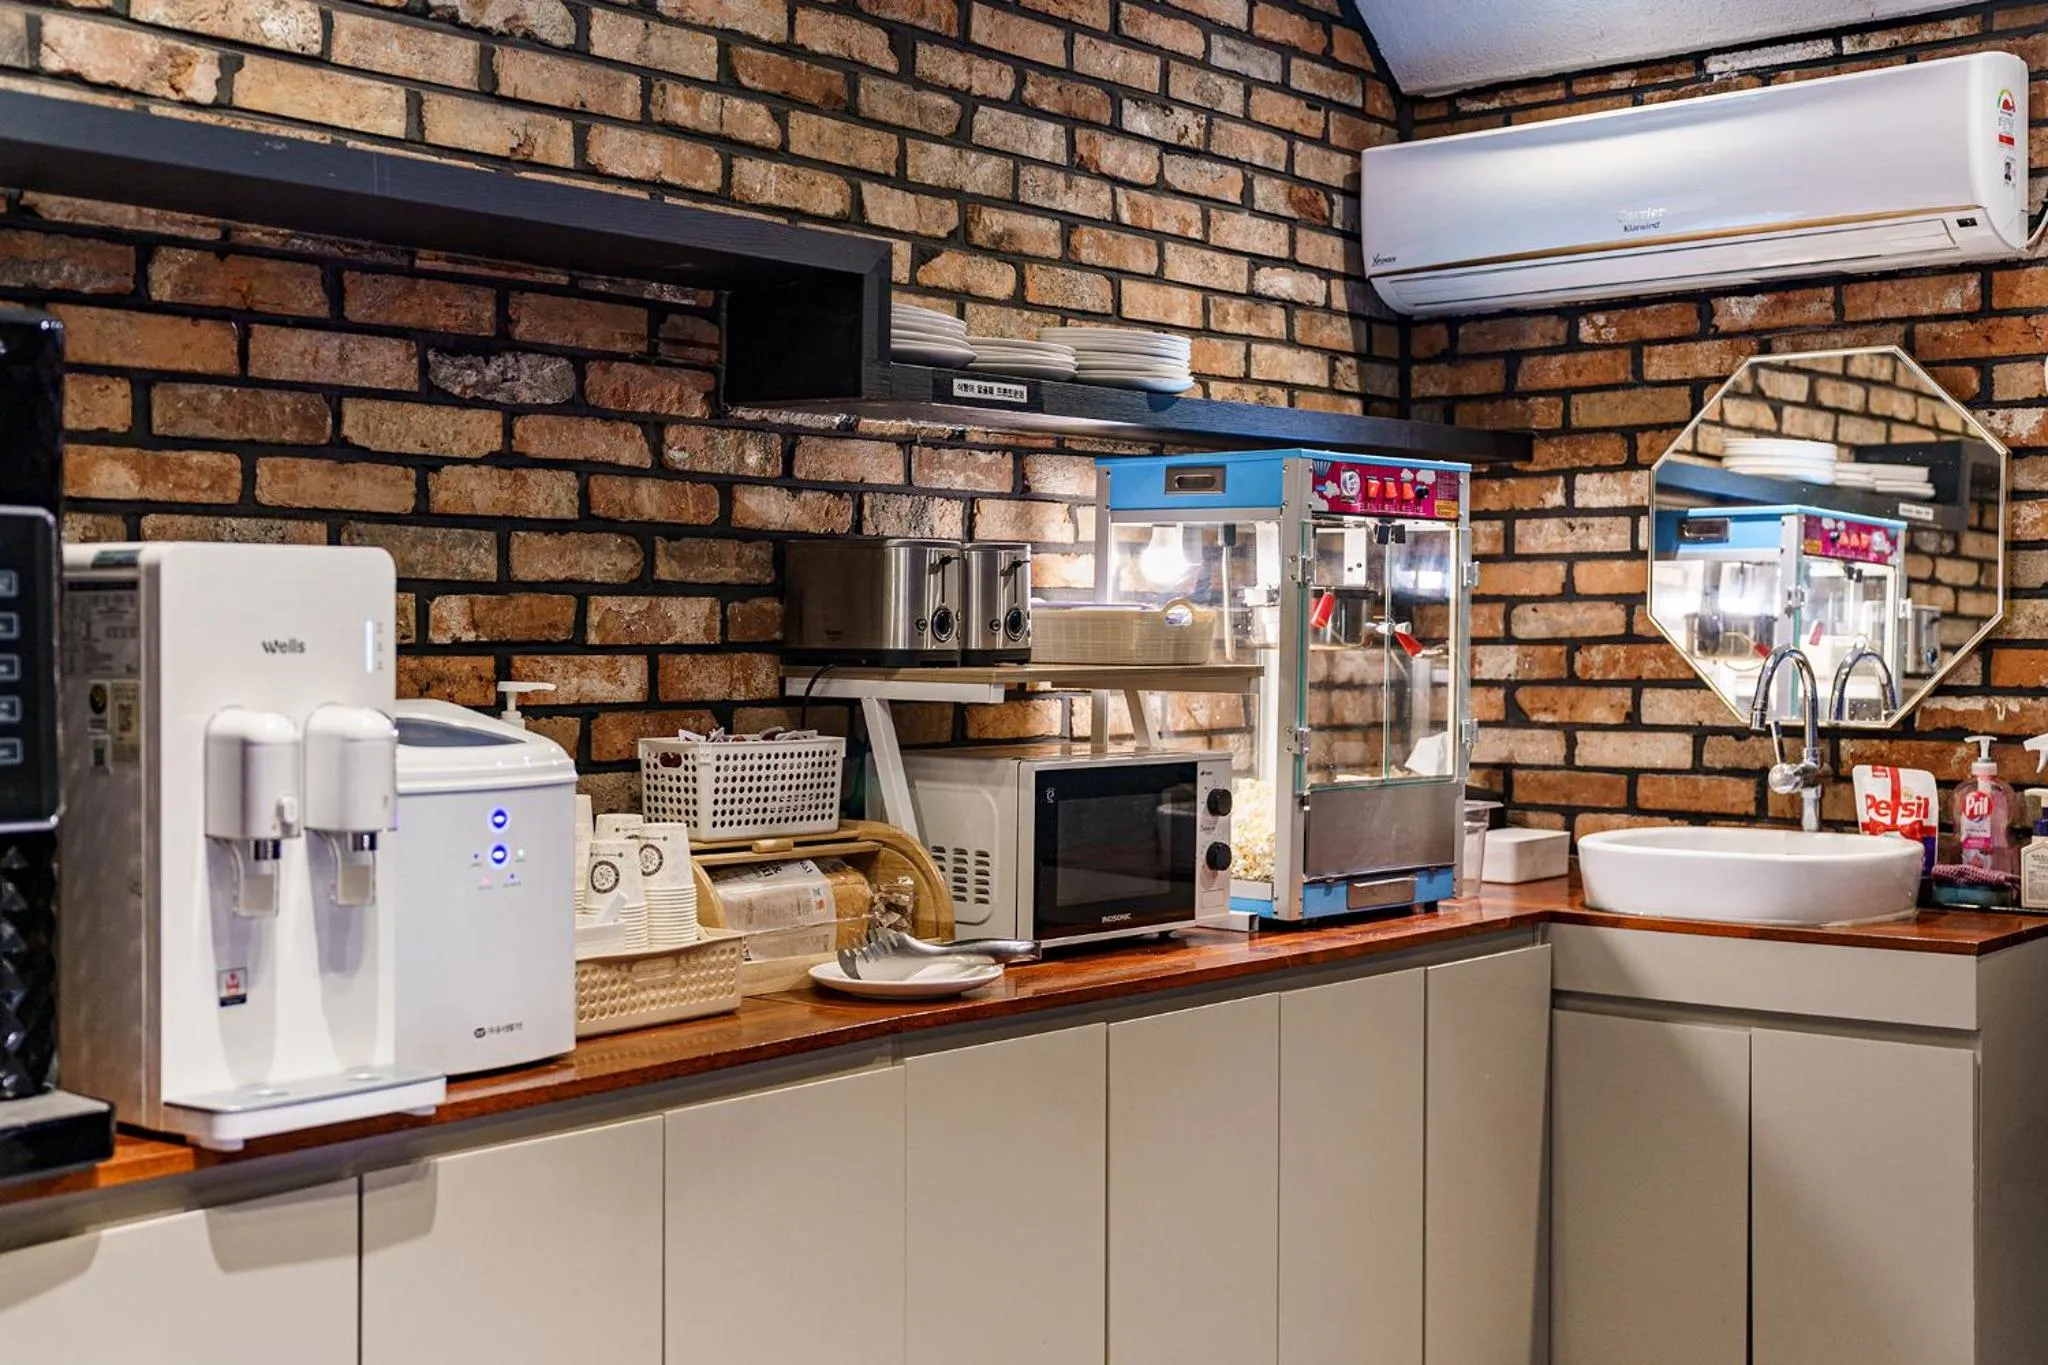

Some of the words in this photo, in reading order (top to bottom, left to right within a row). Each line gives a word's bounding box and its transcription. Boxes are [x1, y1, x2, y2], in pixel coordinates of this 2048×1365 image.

[261, 638, 305, 655] Wells
[1865, 793, 1930, 818] Persil
[1966, 793, 1989, 815] Pril
